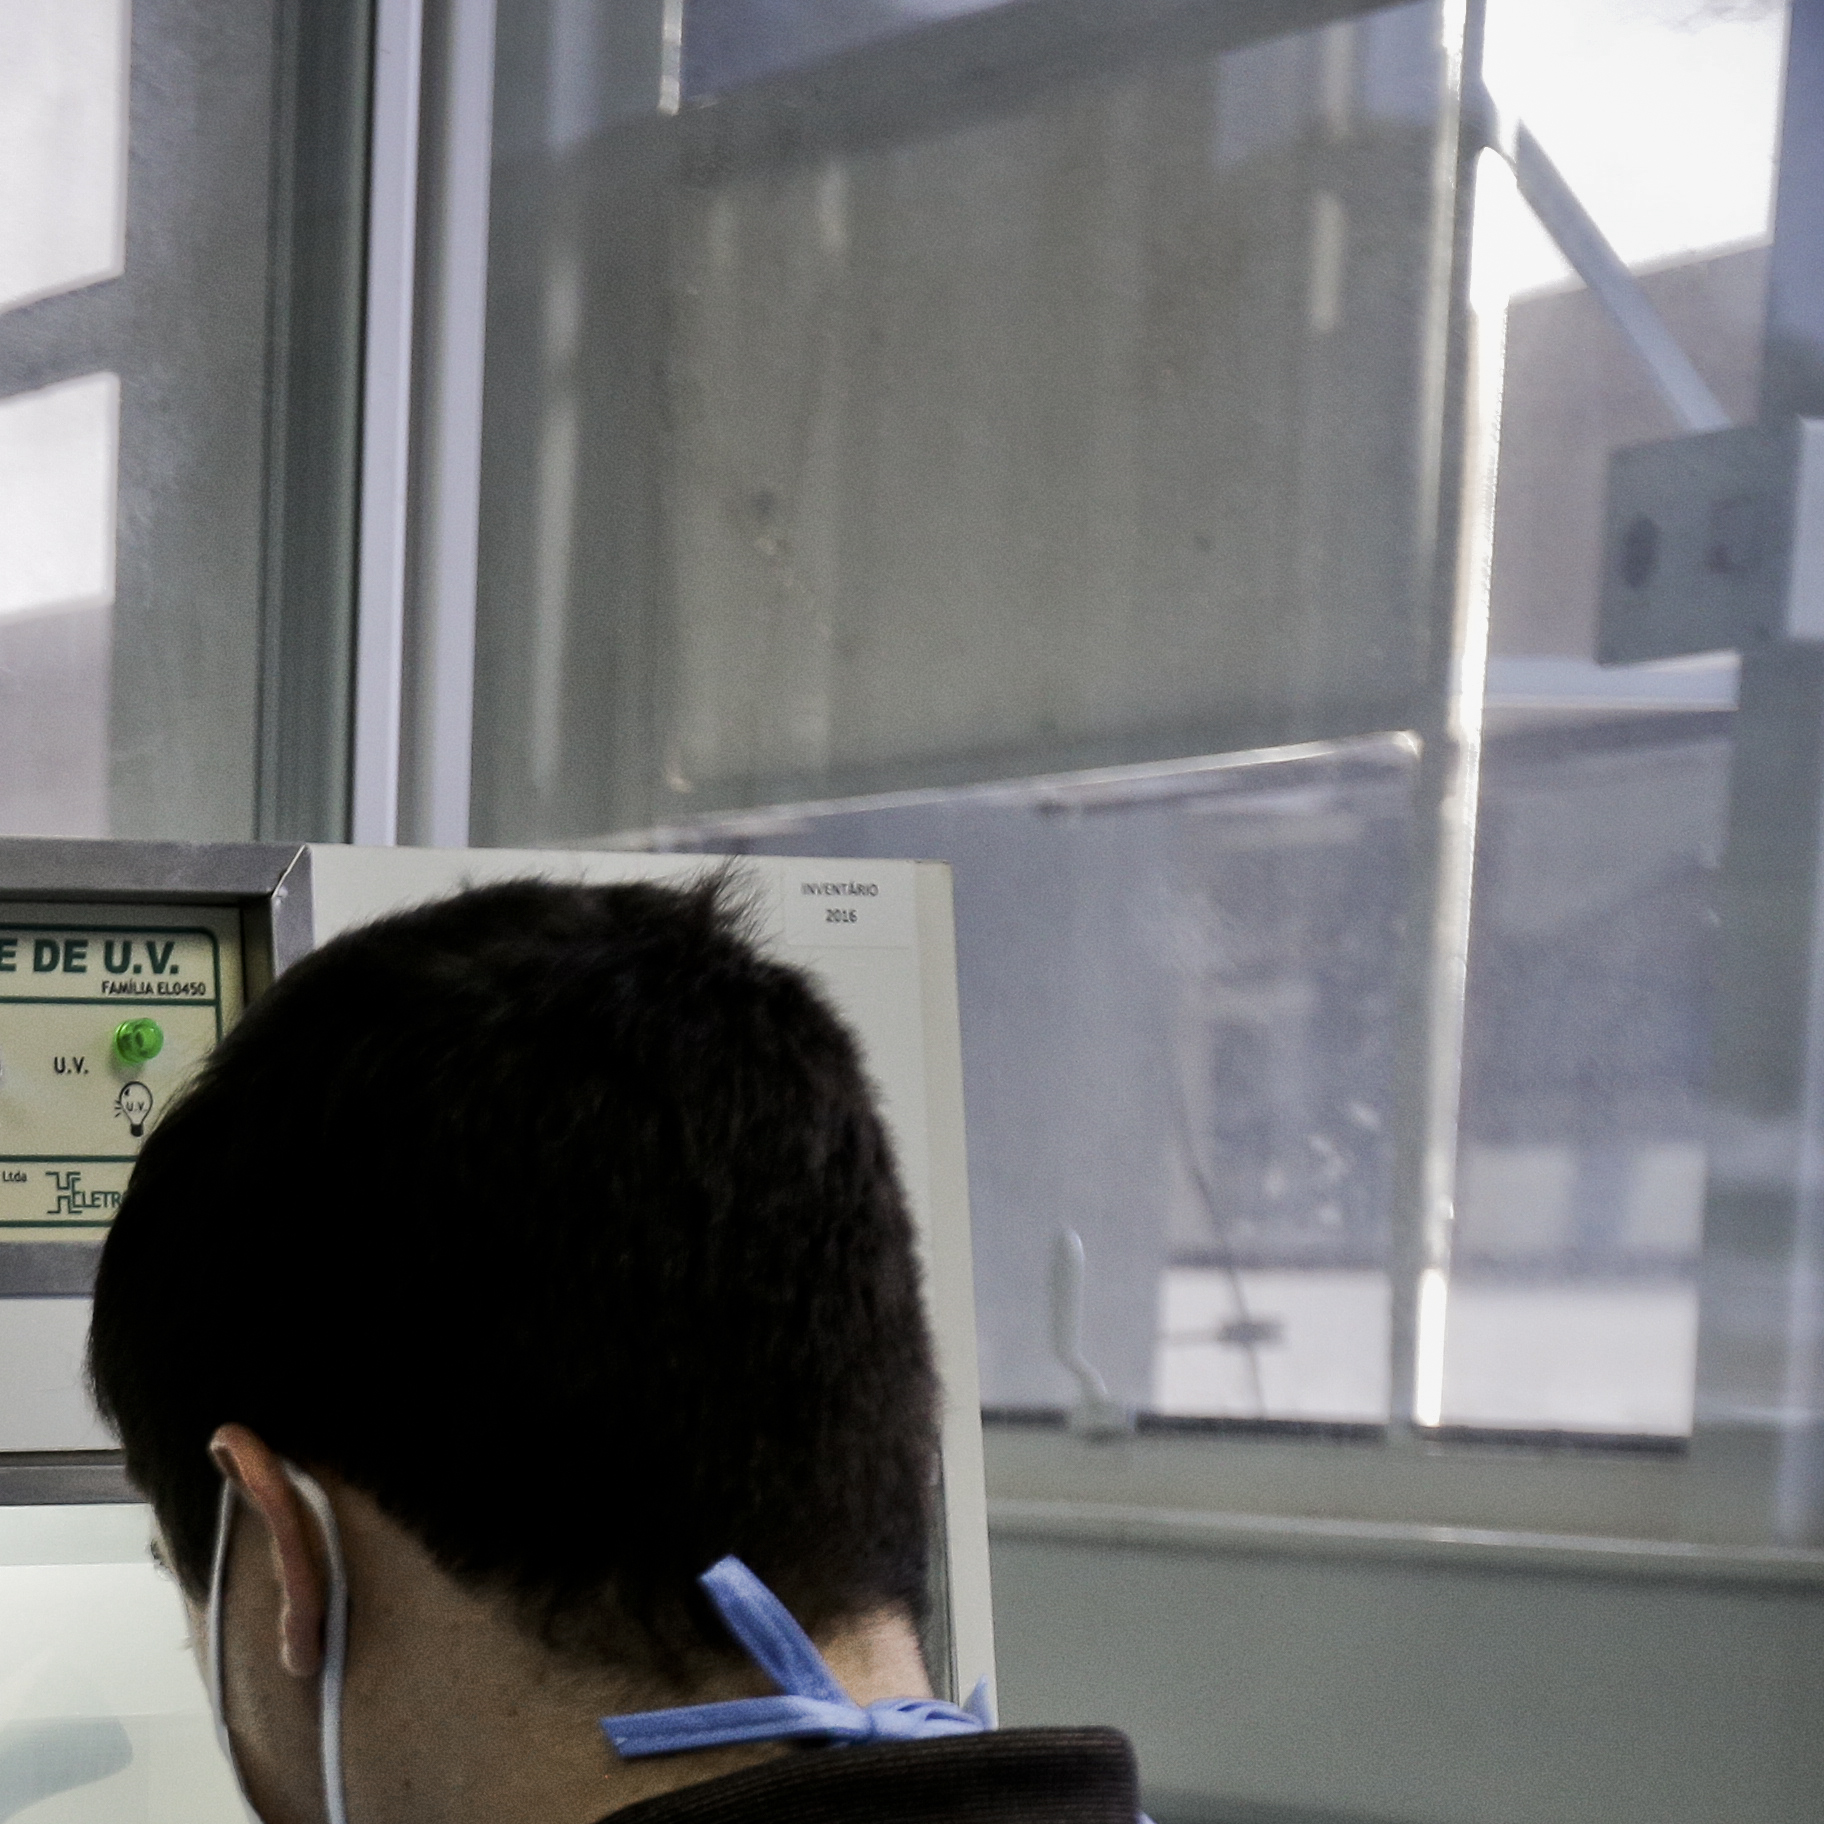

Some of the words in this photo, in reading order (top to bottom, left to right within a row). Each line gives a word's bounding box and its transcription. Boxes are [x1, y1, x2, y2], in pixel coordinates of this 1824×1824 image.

[825, 908, 858, 923] 2016
[32, 938, 88, 973] DE
[104, 940, 180, 975] U.V.
[101, 978, 155, 995] FAMÍLIA
[53, 1056, 89, 1075] U.V.
[2, 1170, 27, 1183] Ltda
